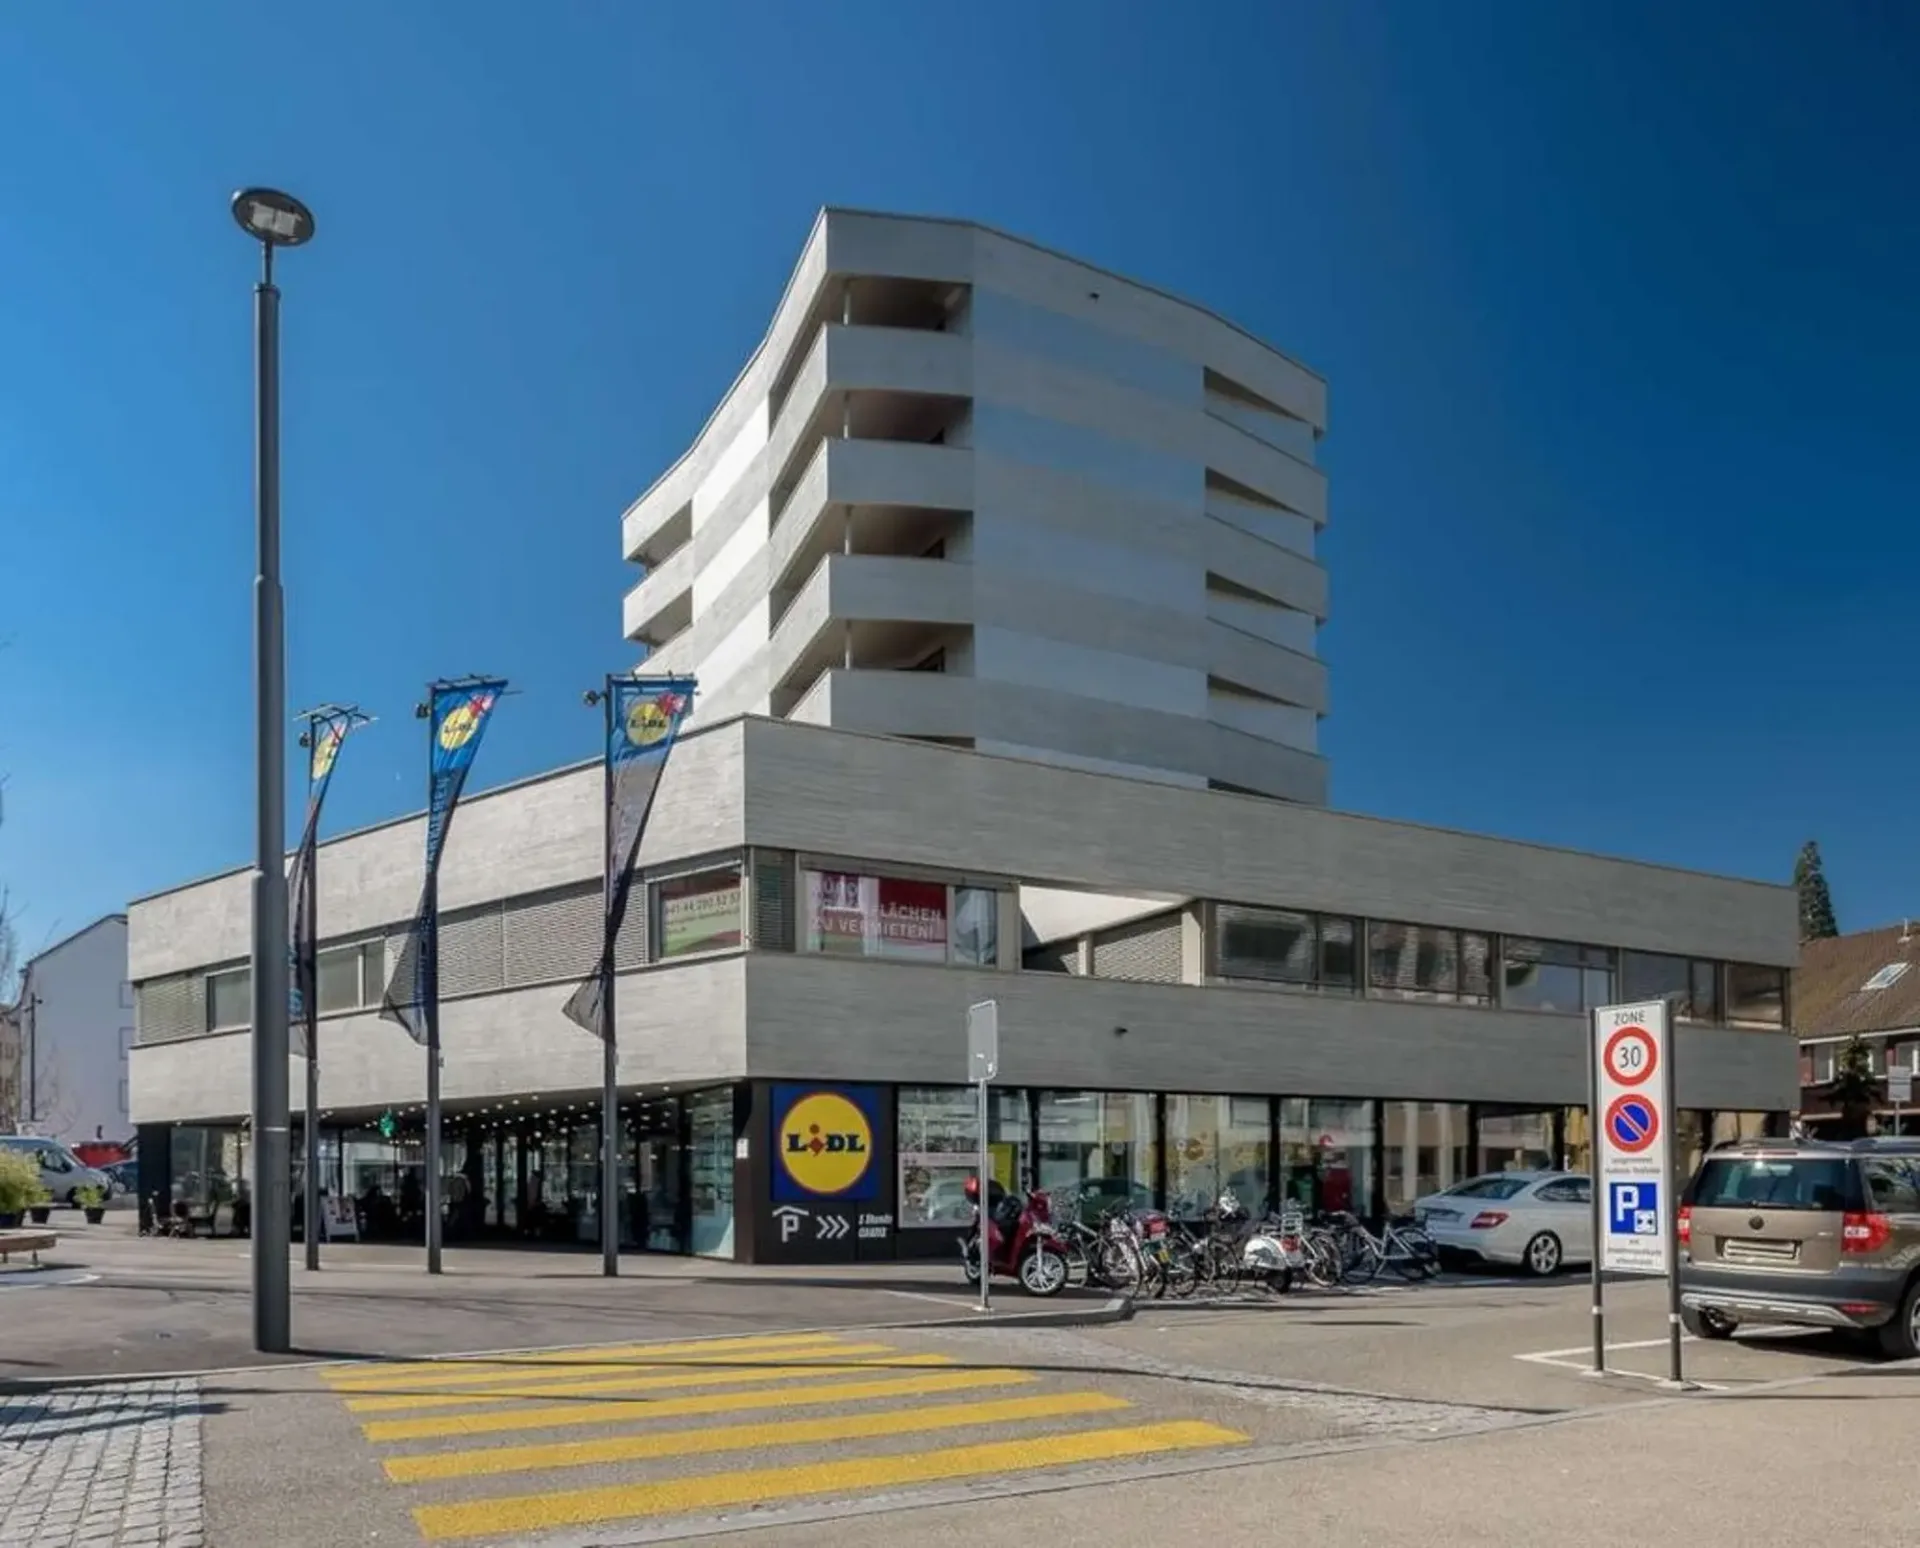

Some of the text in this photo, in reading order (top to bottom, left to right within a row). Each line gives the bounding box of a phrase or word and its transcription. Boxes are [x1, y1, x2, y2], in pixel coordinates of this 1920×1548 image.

[1614, 1010, 1646, 1025] ZONE
[1619, 1046, 1641, 1068] 30
[787, 1123, 865, 1157] LIDL
